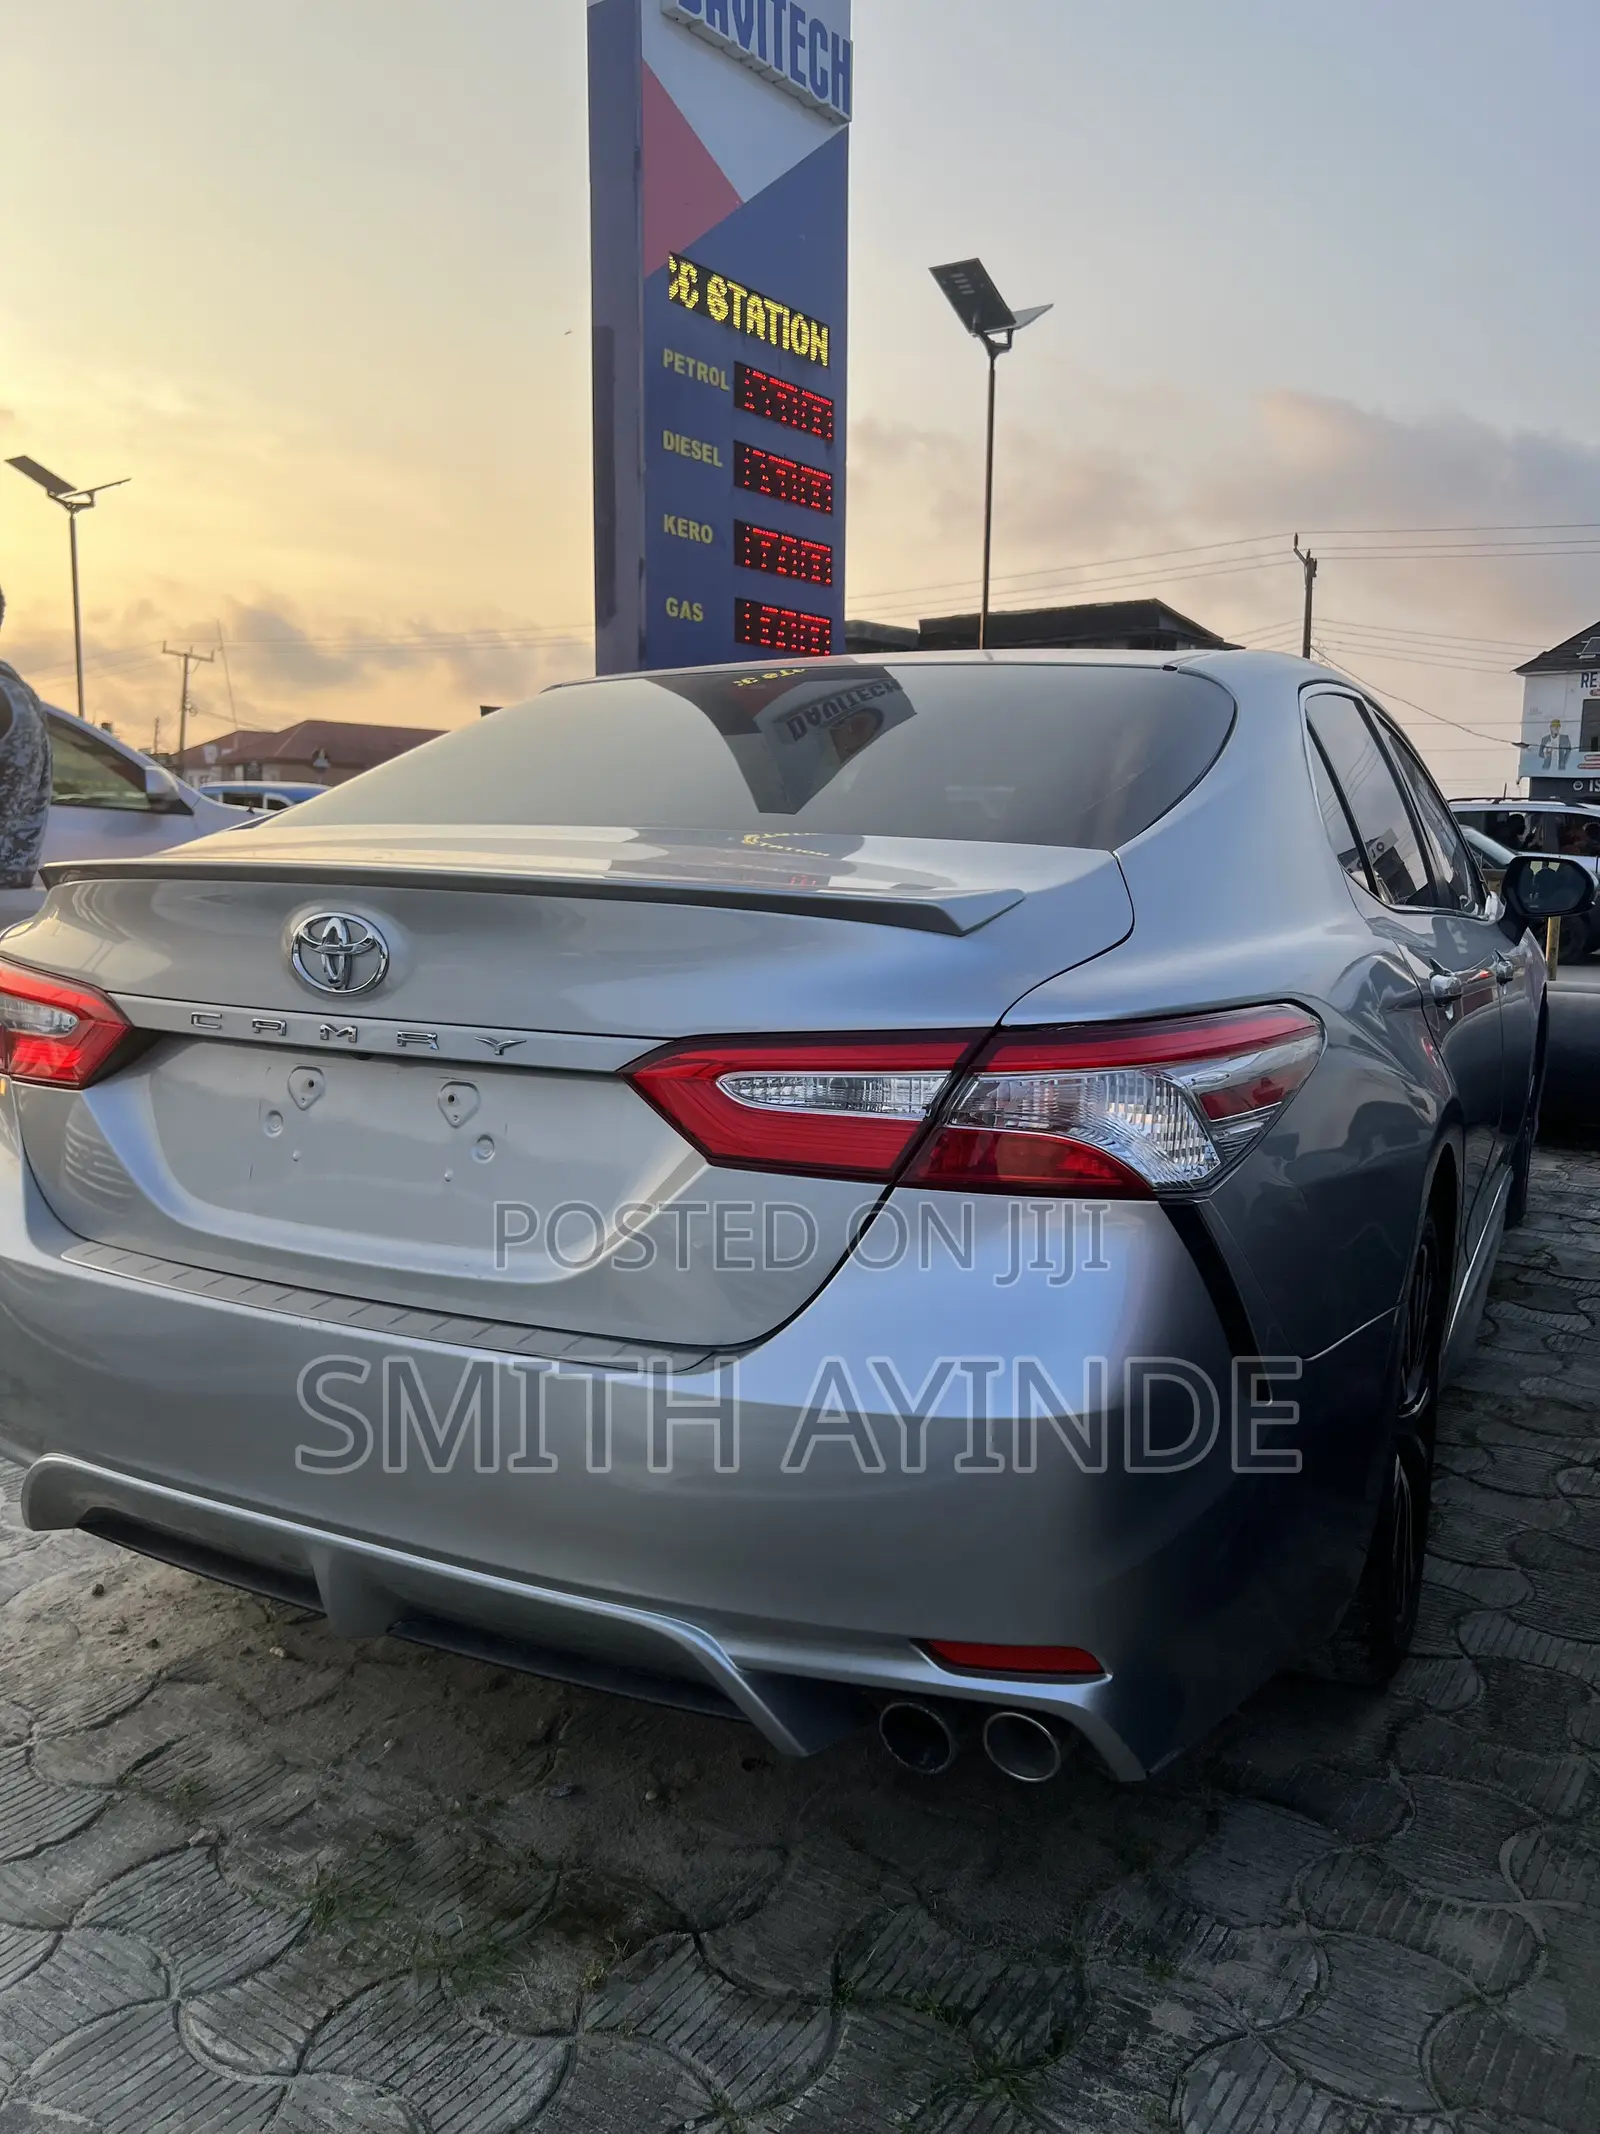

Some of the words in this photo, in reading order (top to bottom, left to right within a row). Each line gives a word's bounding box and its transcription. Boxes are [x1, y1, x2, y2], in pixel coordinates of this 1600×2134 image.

[678, 0, 850, 116] VITECH
[707, 274, 828, 366] STATION
[663, 348, 730, 391] PETROL
[663, 430, 724, 467] DIESEL
[664, 514, 713, 544] KERO
[666, 597, 704, 622] GAS
[190, 1012, 527, 1055] CAMRY
